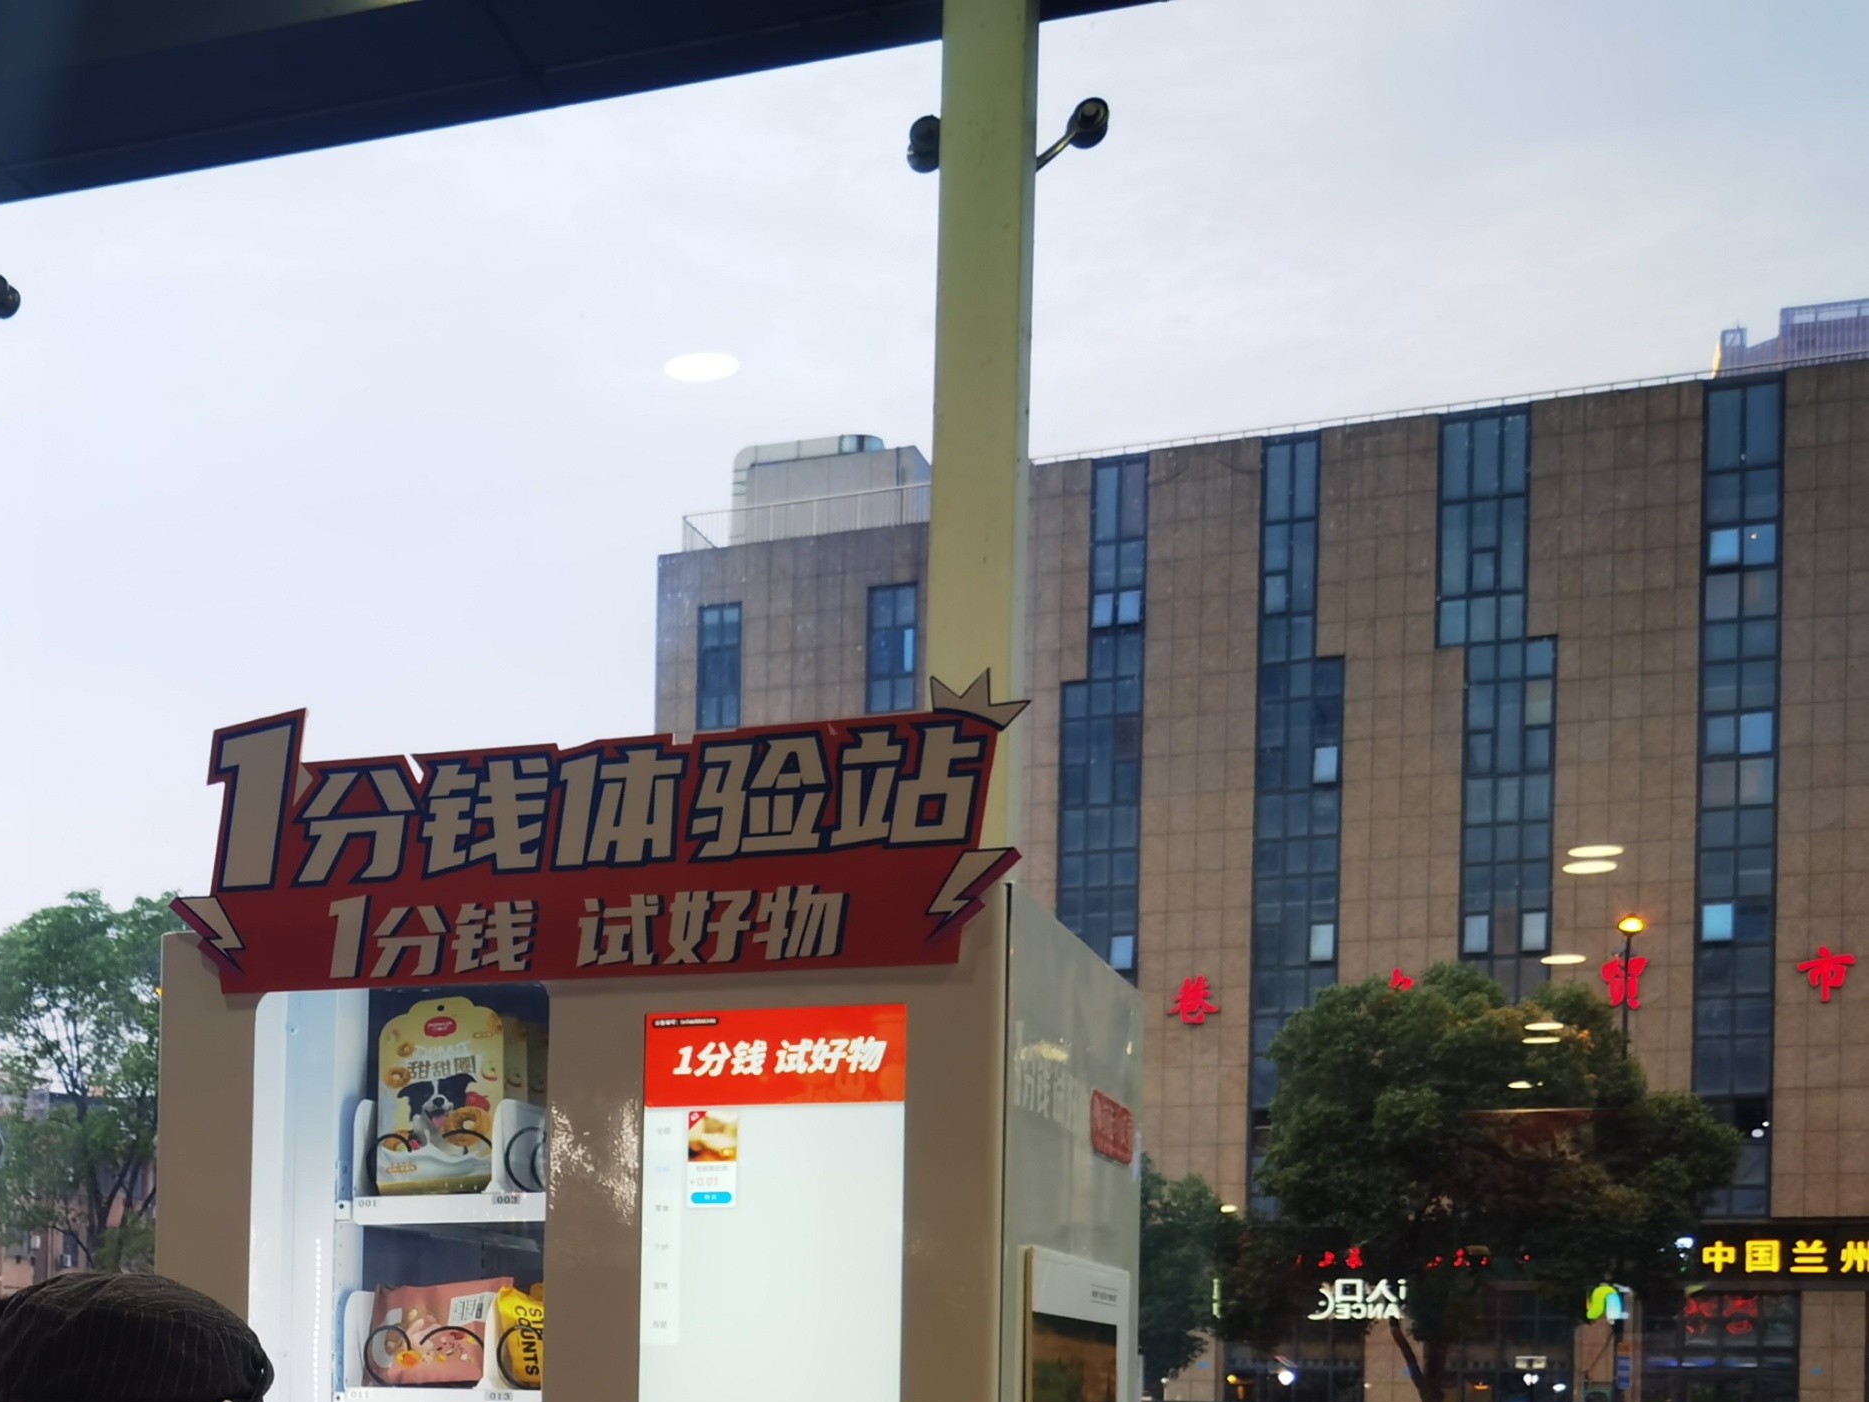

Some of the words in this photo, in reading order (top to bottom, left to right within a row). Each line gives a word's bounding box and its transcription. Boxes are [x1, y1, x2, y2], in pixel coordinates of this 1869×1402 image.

[216, 718, 987, 890] 1分钱体验站
[328, 895, 537, 979] 1分钱
[576, 884, 849, 968] 试好物
[408, 1055, 477, 1081] 甜甜圈
[672, 1038, 768, 1077] 1分钱
[773, 1035, 887, 1075] 试好物
[1701, 1239, 1869, 1273] 中国兰州
[514, 1305, 540, 1377] COUNTS
[489, 1391, 511, 1401] 013
